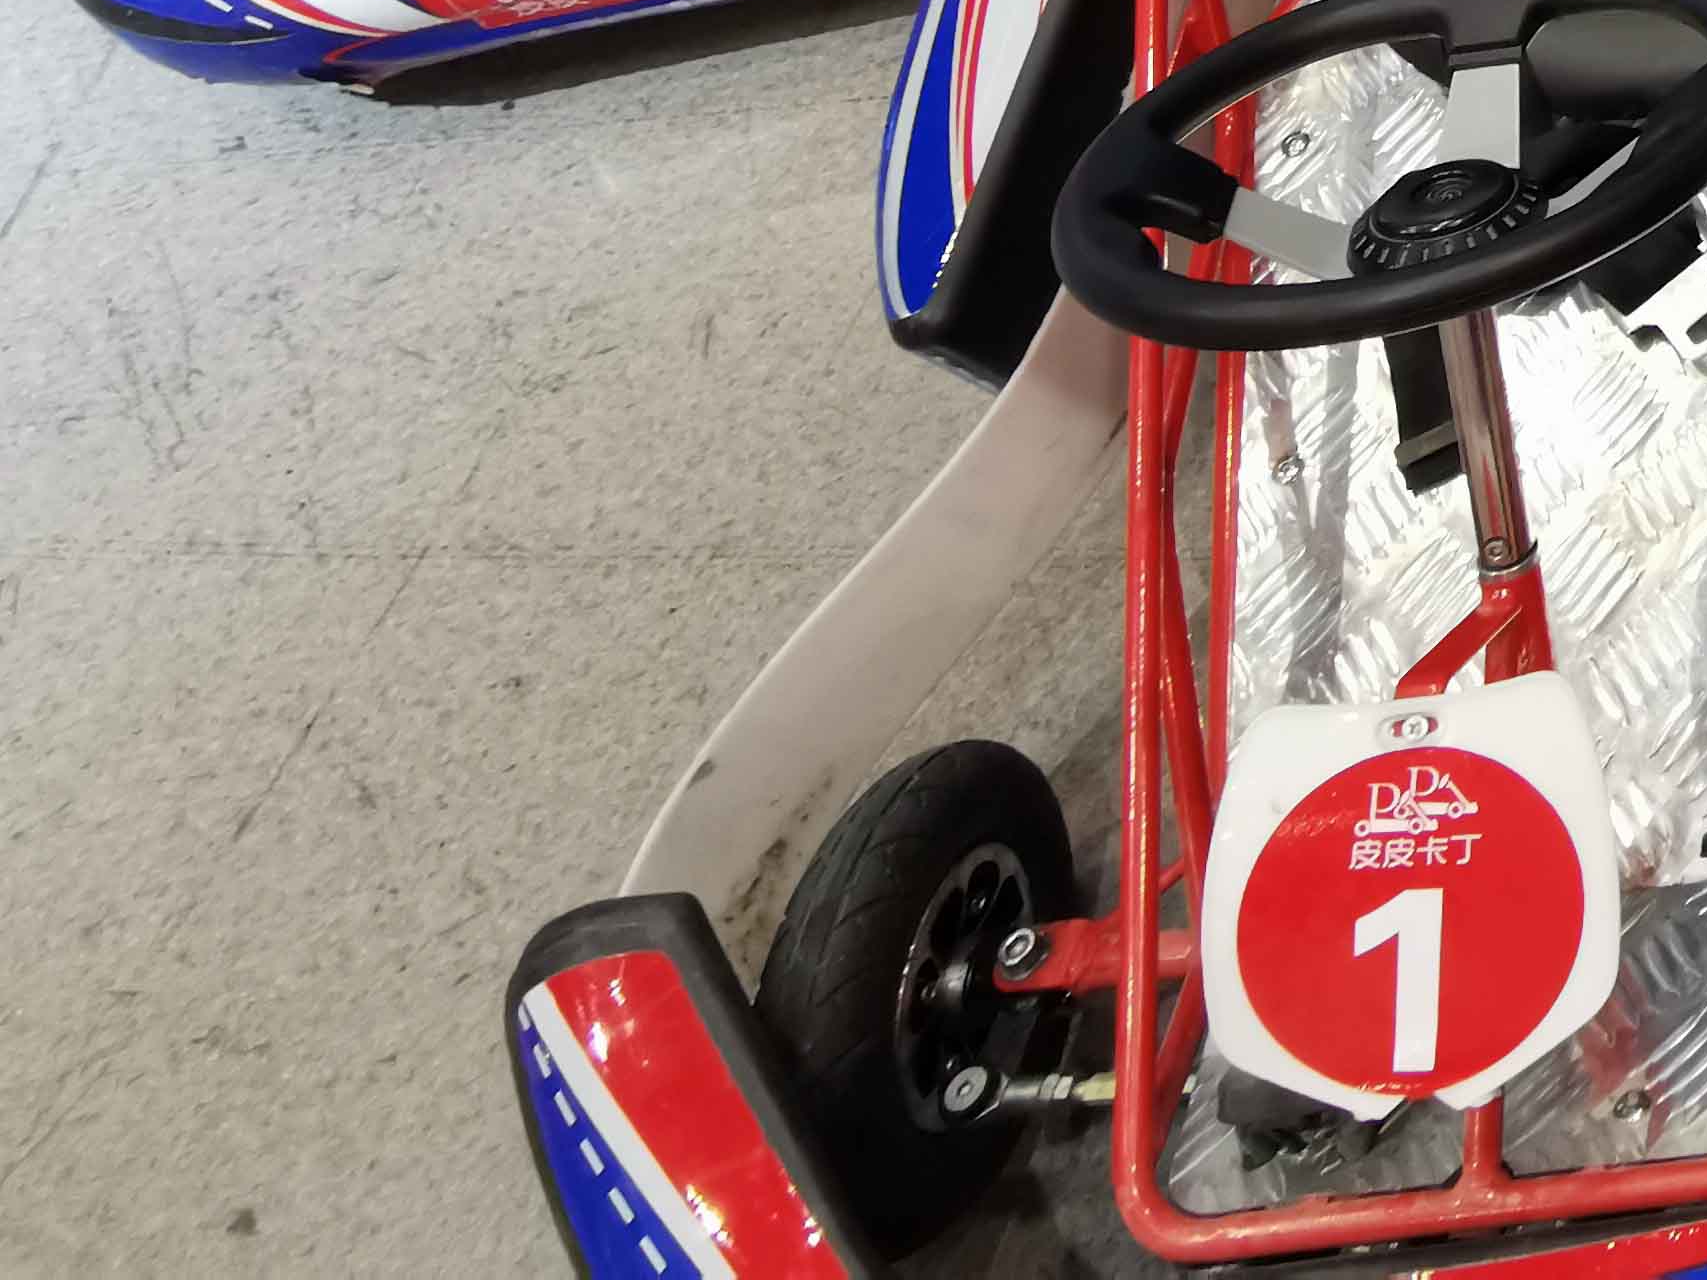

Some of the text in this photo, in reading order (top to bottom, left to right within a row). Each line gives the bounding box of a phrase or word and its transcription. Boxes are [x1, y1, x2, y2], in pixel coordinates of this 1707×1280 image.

[1348, 834, 1484, 871] 皮皮卡丁
[1354, 887, 1444, 1073] 1
